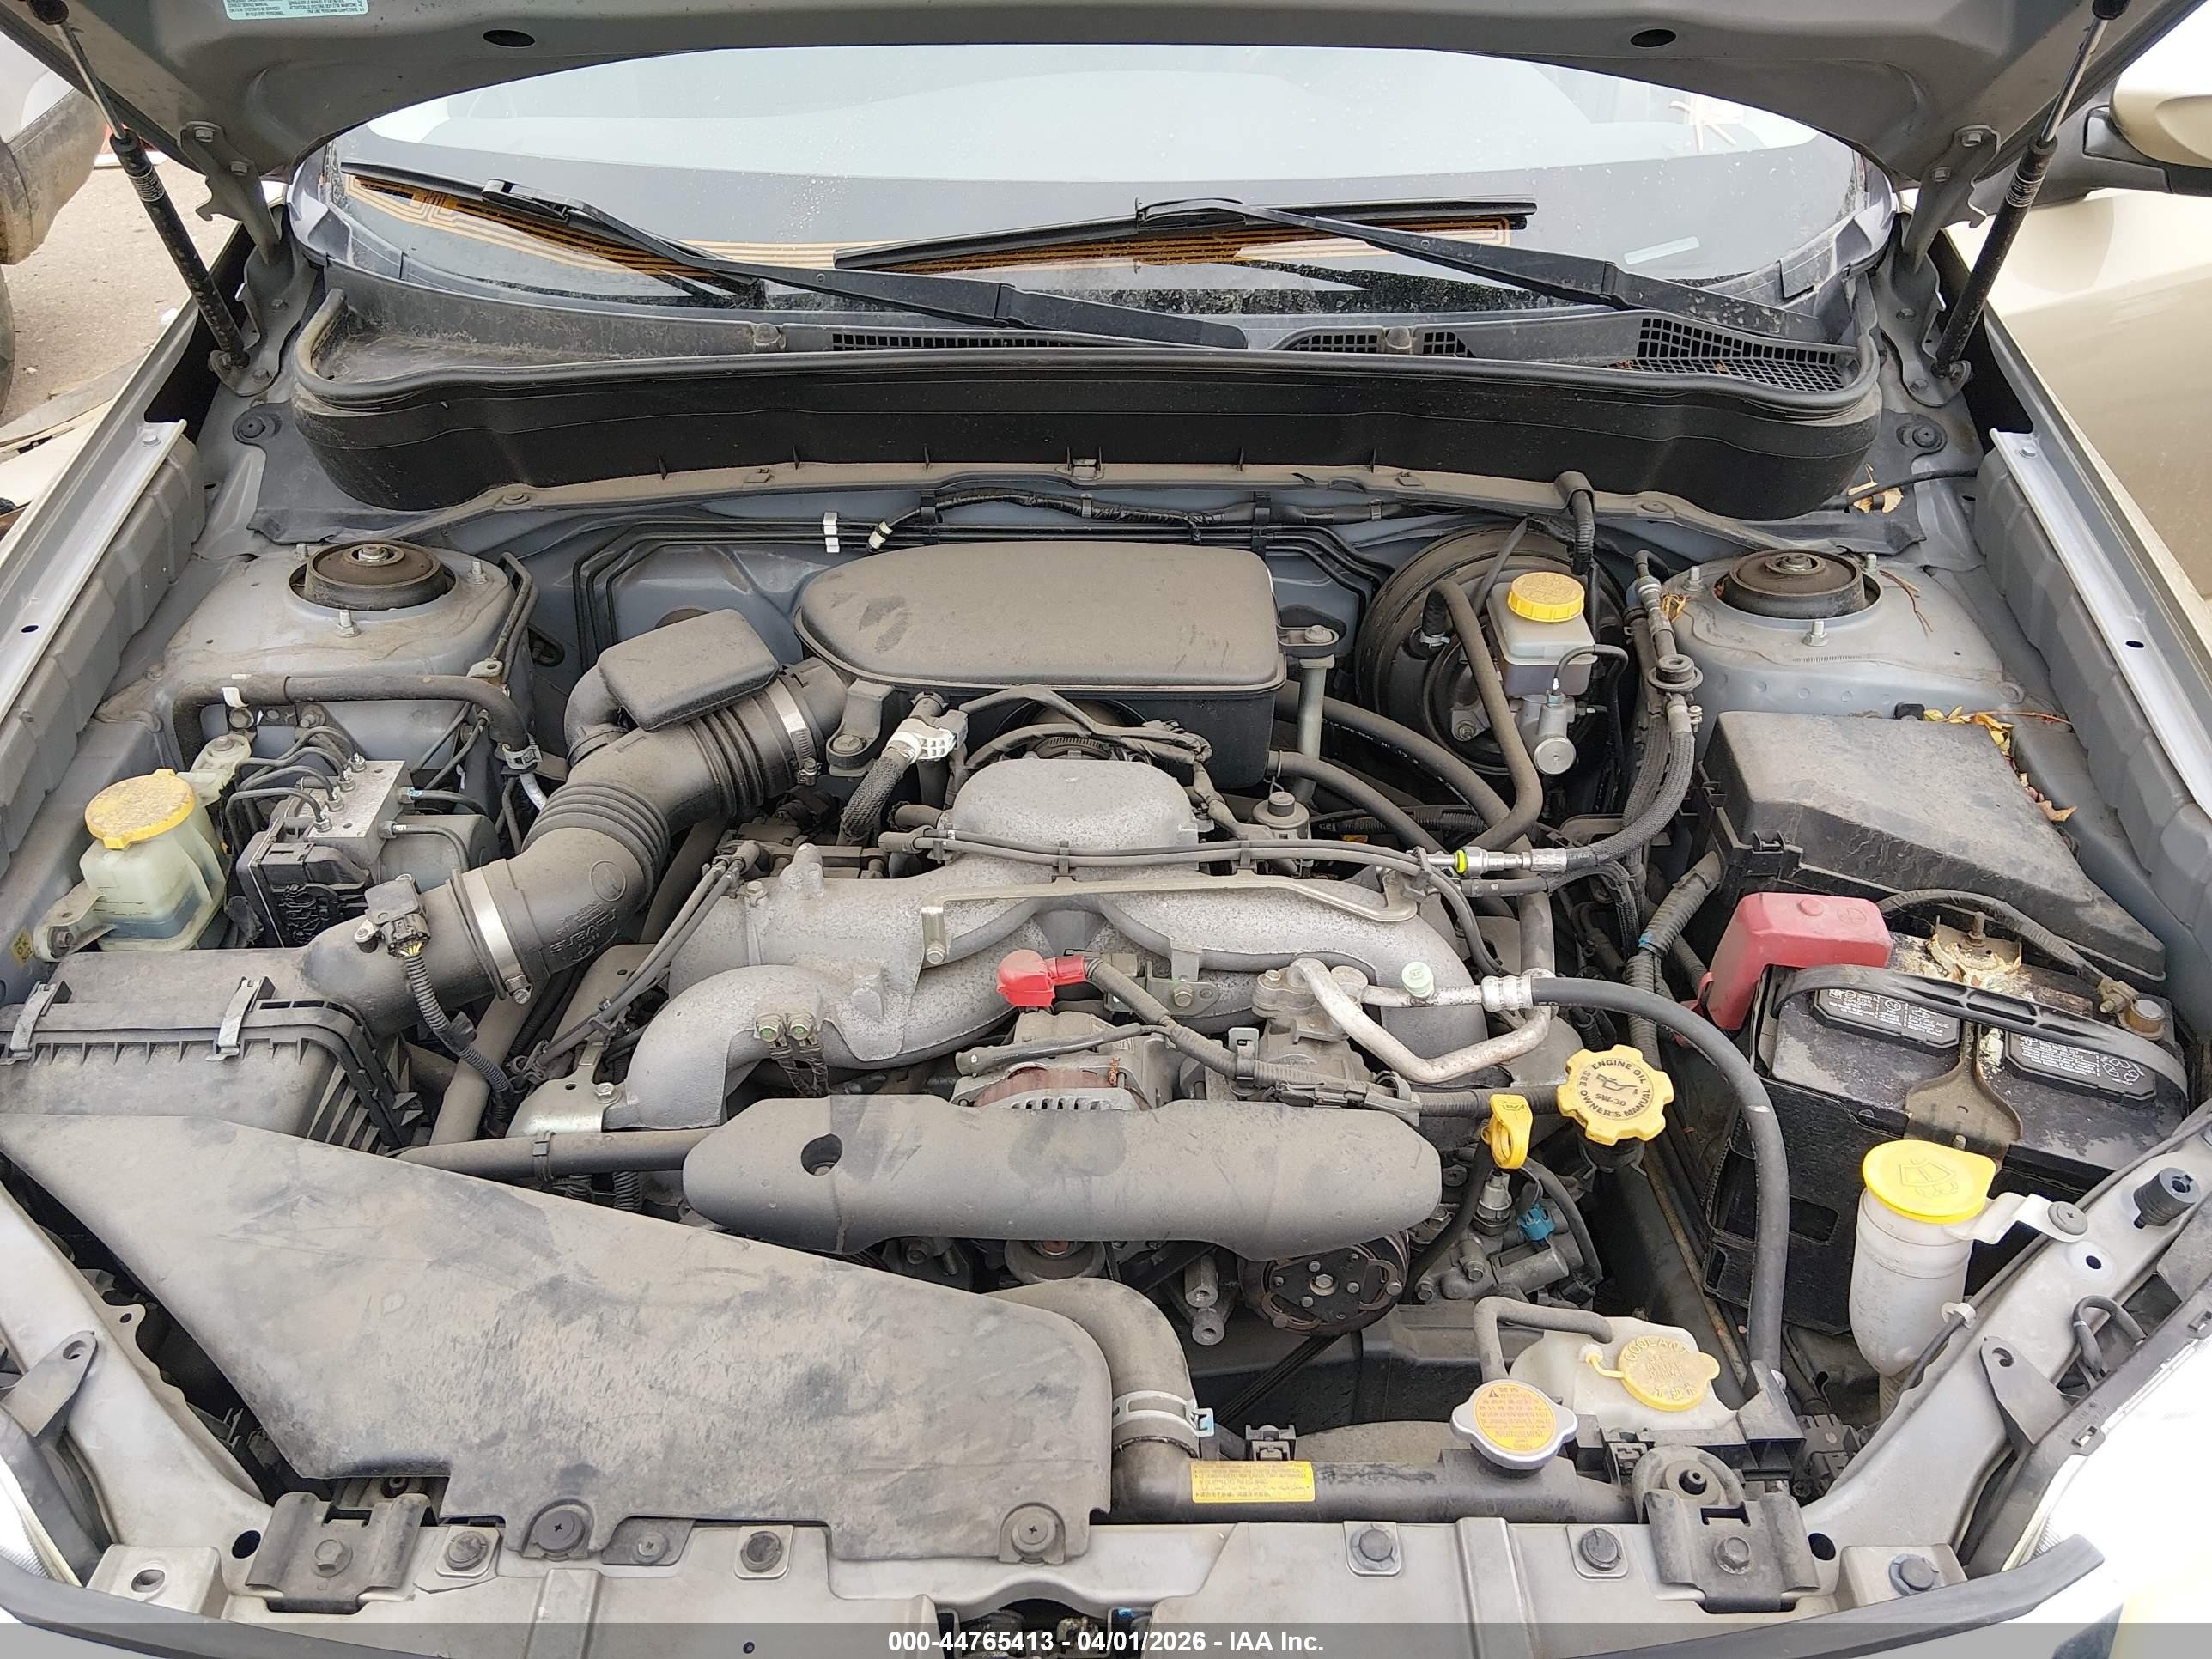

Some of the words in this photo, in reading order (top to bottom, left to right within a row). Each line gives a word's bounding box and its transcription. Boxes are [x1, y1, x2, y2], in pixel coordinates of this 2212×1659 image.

[1579, 1070, 1592, 1086] SEE
[1591, 1059, 1632, 1070] ENGINE
[1633, 1068, 1648, 1084] OIL
[1580, 1089, 1621, 1118] OWNER'S
[1595, 1093, 1627, 1107] 5W-30
[1624, 1088, 1651, 1117] MANUAL
[1624, 1337, 1690, 1361] COOLANT
